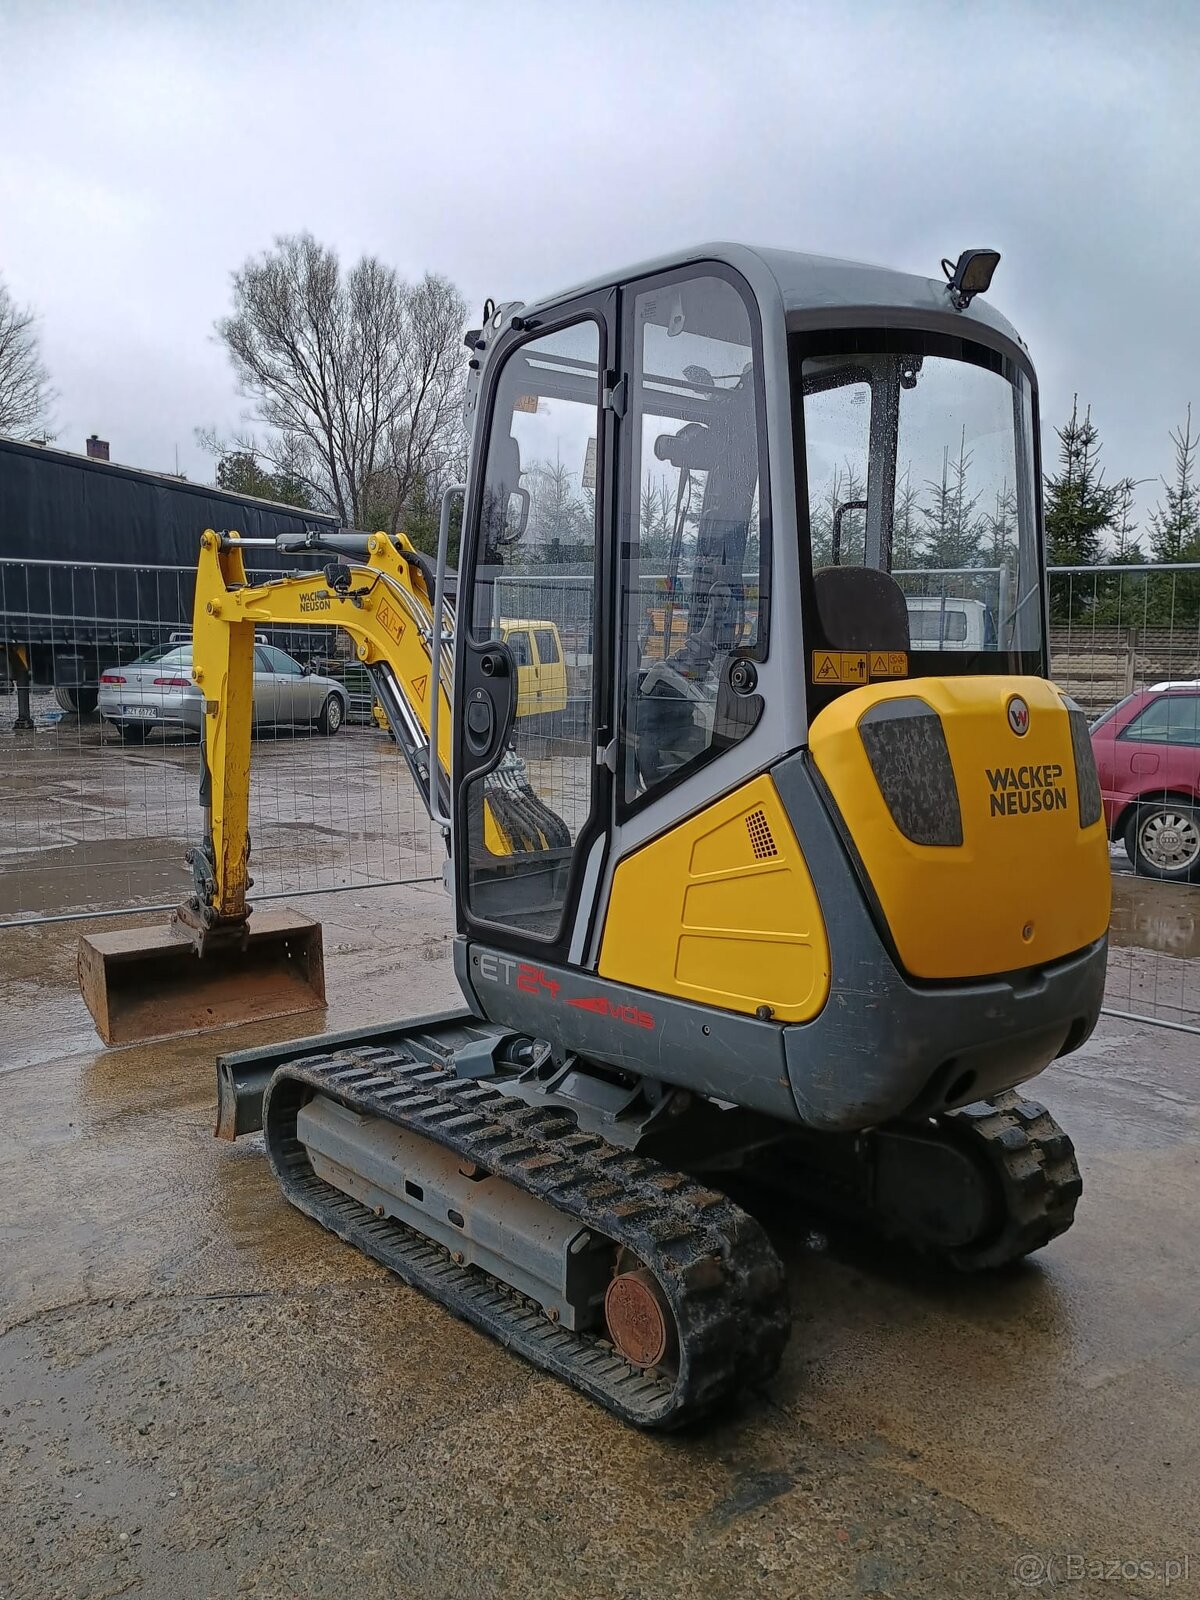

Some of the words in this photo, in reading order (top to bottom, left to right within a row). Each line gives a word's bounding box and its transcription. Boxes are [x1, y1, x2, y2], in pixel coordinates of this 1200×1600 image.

[299, 592, 327, 602] WACK
[300, 600, 330, 612] NEUSON
[989, 787, 1067, 817] NEUSON
